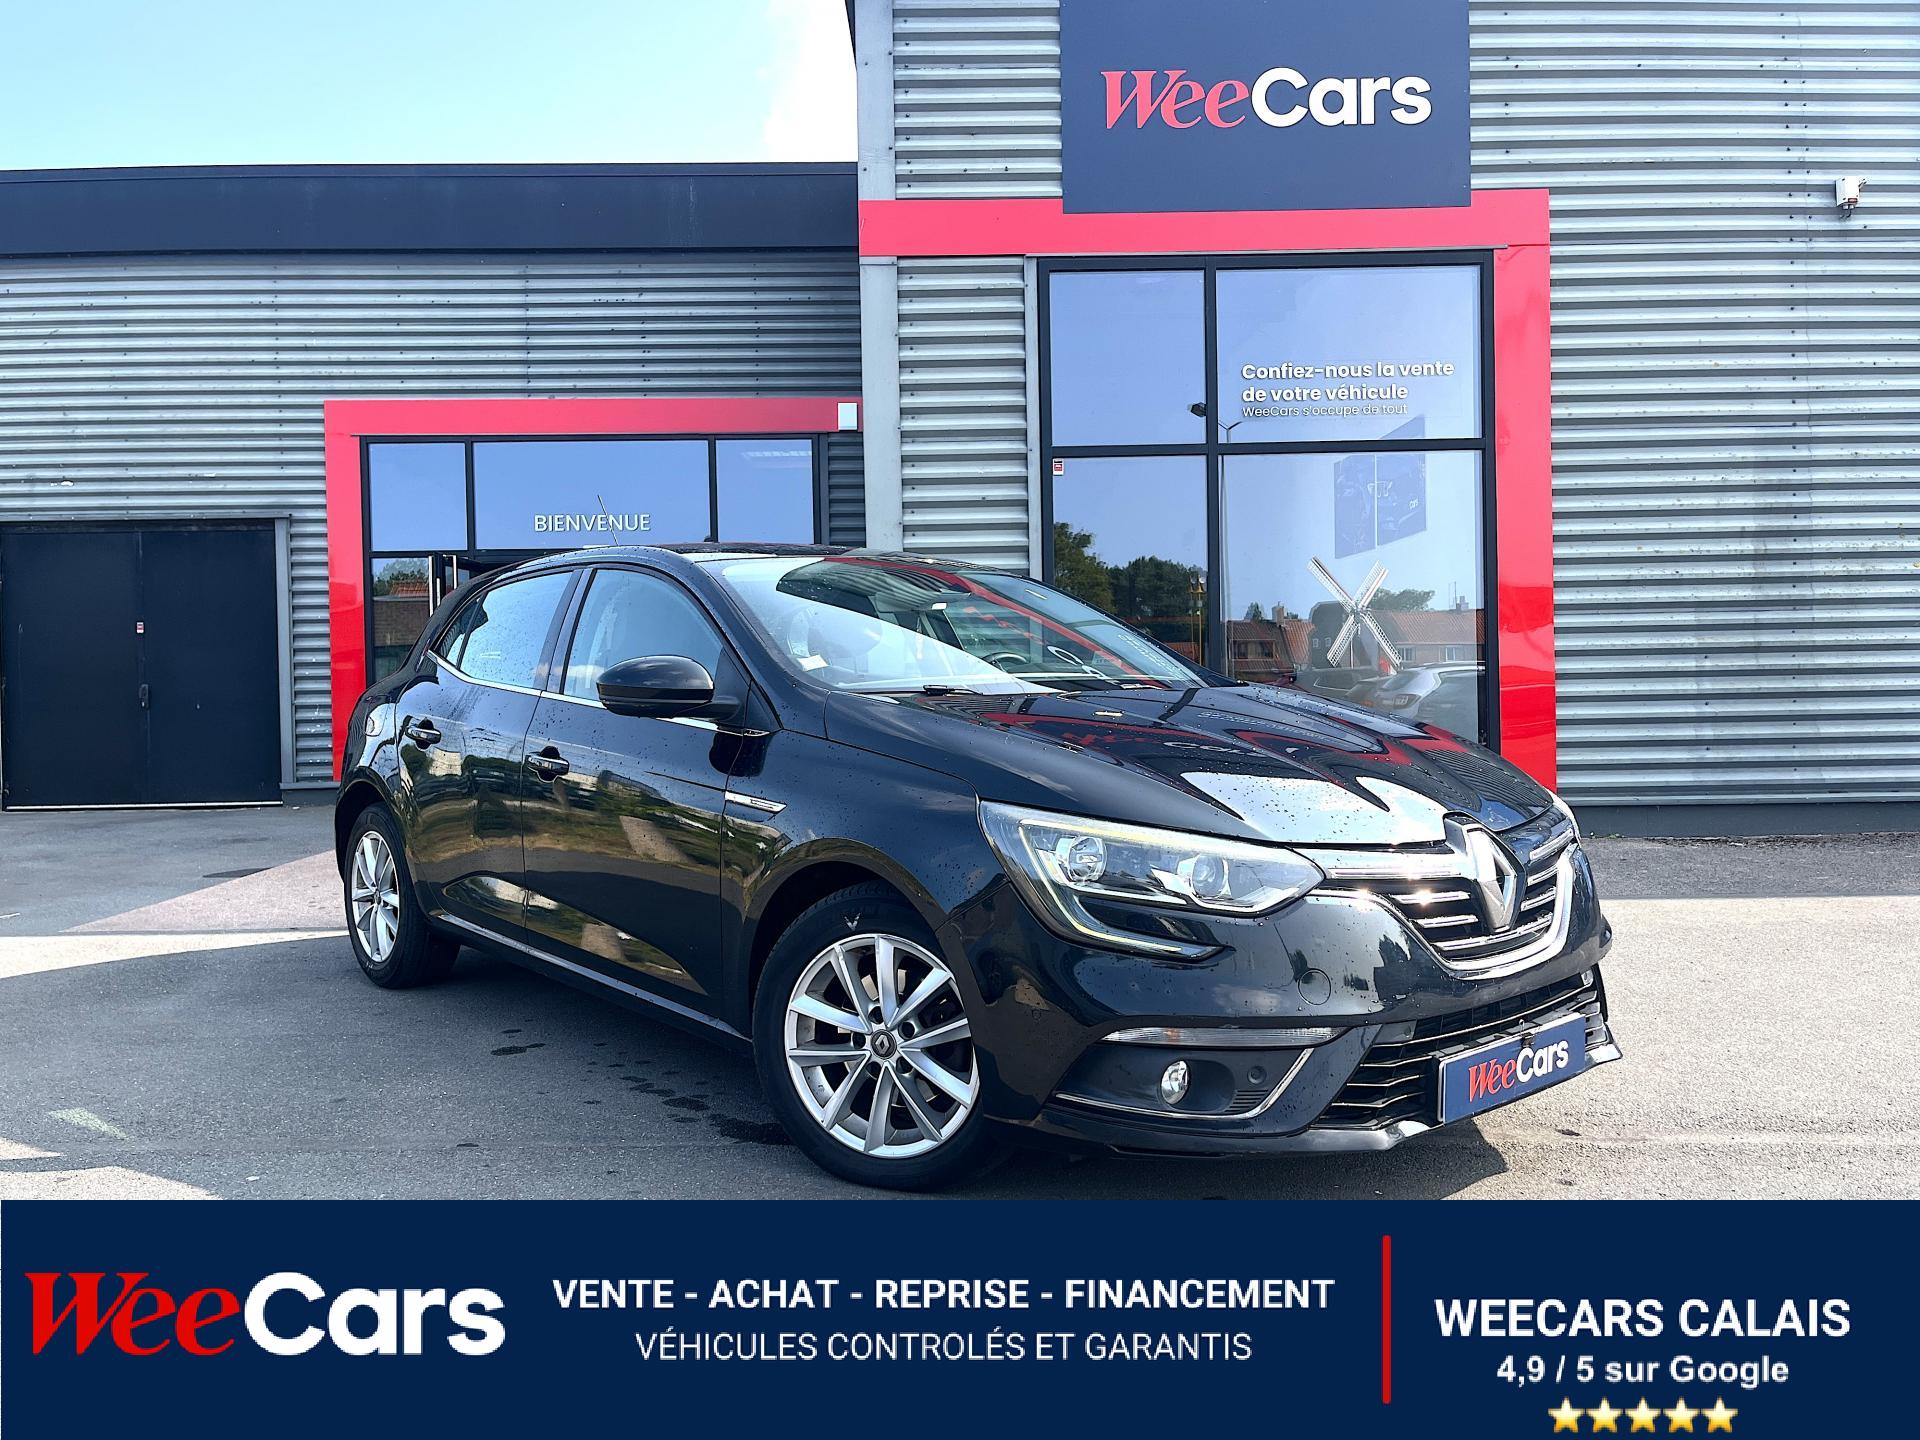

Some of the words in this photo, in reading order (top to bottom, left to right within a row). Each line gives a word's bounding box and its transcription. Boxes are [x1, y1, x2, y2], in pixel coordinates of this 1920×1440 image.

[1100, 66, 1433, 129] WeeCars
[1241, 361, 1373, 380] Confiez-nous
[1377, 361, 1396, 378] la
[1398, 361, 1455, 377] vente
[1242, 386, 1267, 402] de
[1270, 386, 1322, 401] votre
[1326, 383, 1409, 400] véhicule
[1242, 405, 1300, 418] WeeCars
[1303, 404, 1360, 418] s'occupe
[1363, 403, 1380, 415] de
[1382, 403, 1408, 415] tout
[533, 513, 651, 533] BIENVENUE
[1468, 1040, 1569, 1102] WeeCars
